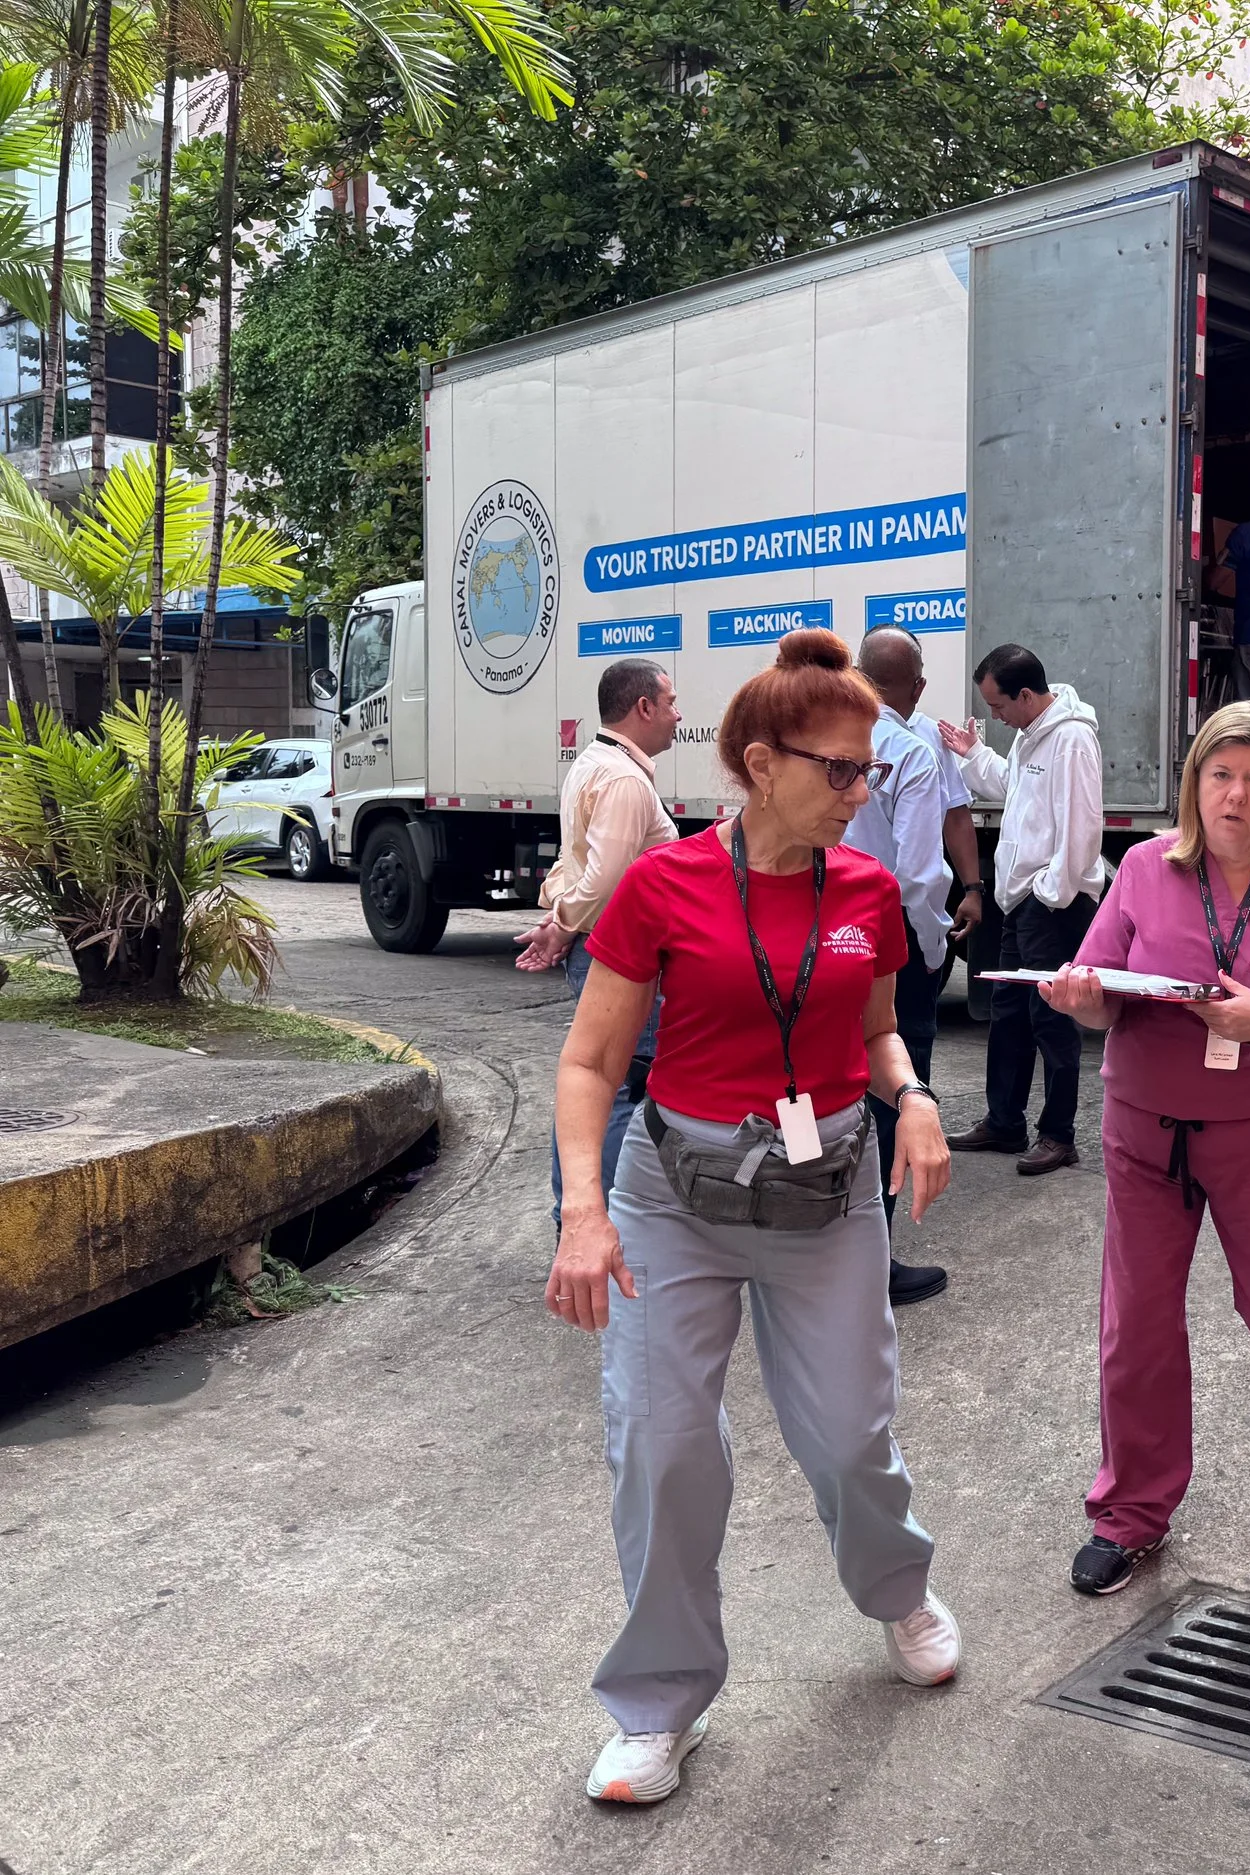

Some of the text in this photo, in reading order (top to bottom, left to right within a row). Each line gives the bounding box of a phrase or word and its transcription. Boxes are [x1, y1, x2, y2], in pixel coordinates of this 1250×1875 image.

[596, 550, 647, 580] YOUR
[651, 537, 738, 573] TRUSTED
[744, 524, 843, 562] PARTNER
[849, 519, 874, 550] IN
[456, 490, 556, 648] CANAL MOVERS & LOGISTICS CORP.
[734, 611, 804, 635] PACKING
[602, 625, 655, 646] MOVING
[485, 664, 523, 682] Panama
[360, 695, 389, 732] 530772
[560, 750, 577, 760] FIDI
